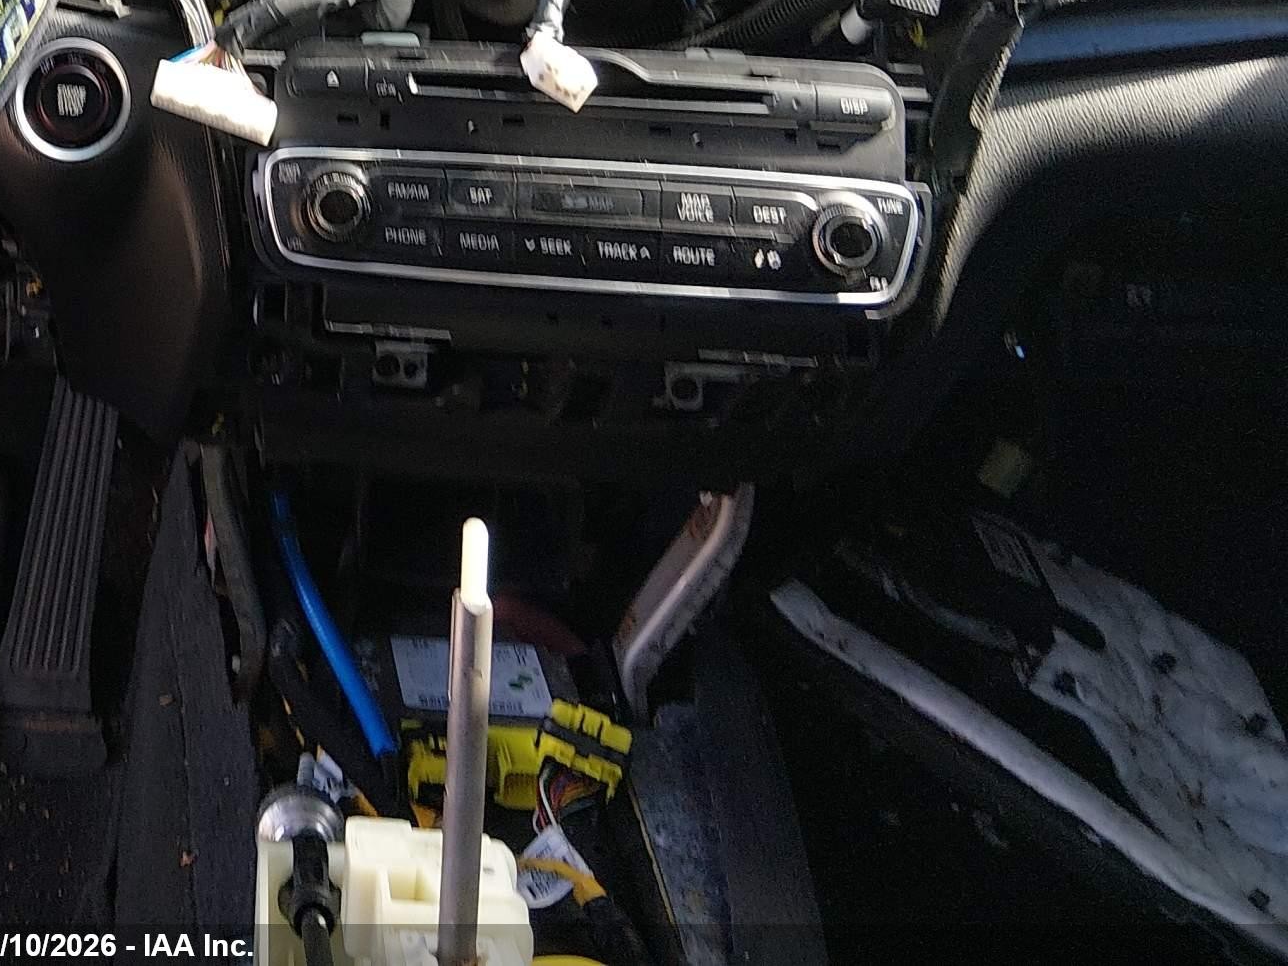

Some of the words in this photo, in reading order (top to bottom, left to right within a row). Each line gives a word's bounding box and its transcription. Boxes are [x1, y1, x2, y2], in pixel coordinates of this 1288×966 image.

[385, 227, 427, 246] PHONE
[459, 232, 500, 252] MEDIA
[597, 240, 638, 260] TRACK
[673, 245, 716, 266] ROUTE
